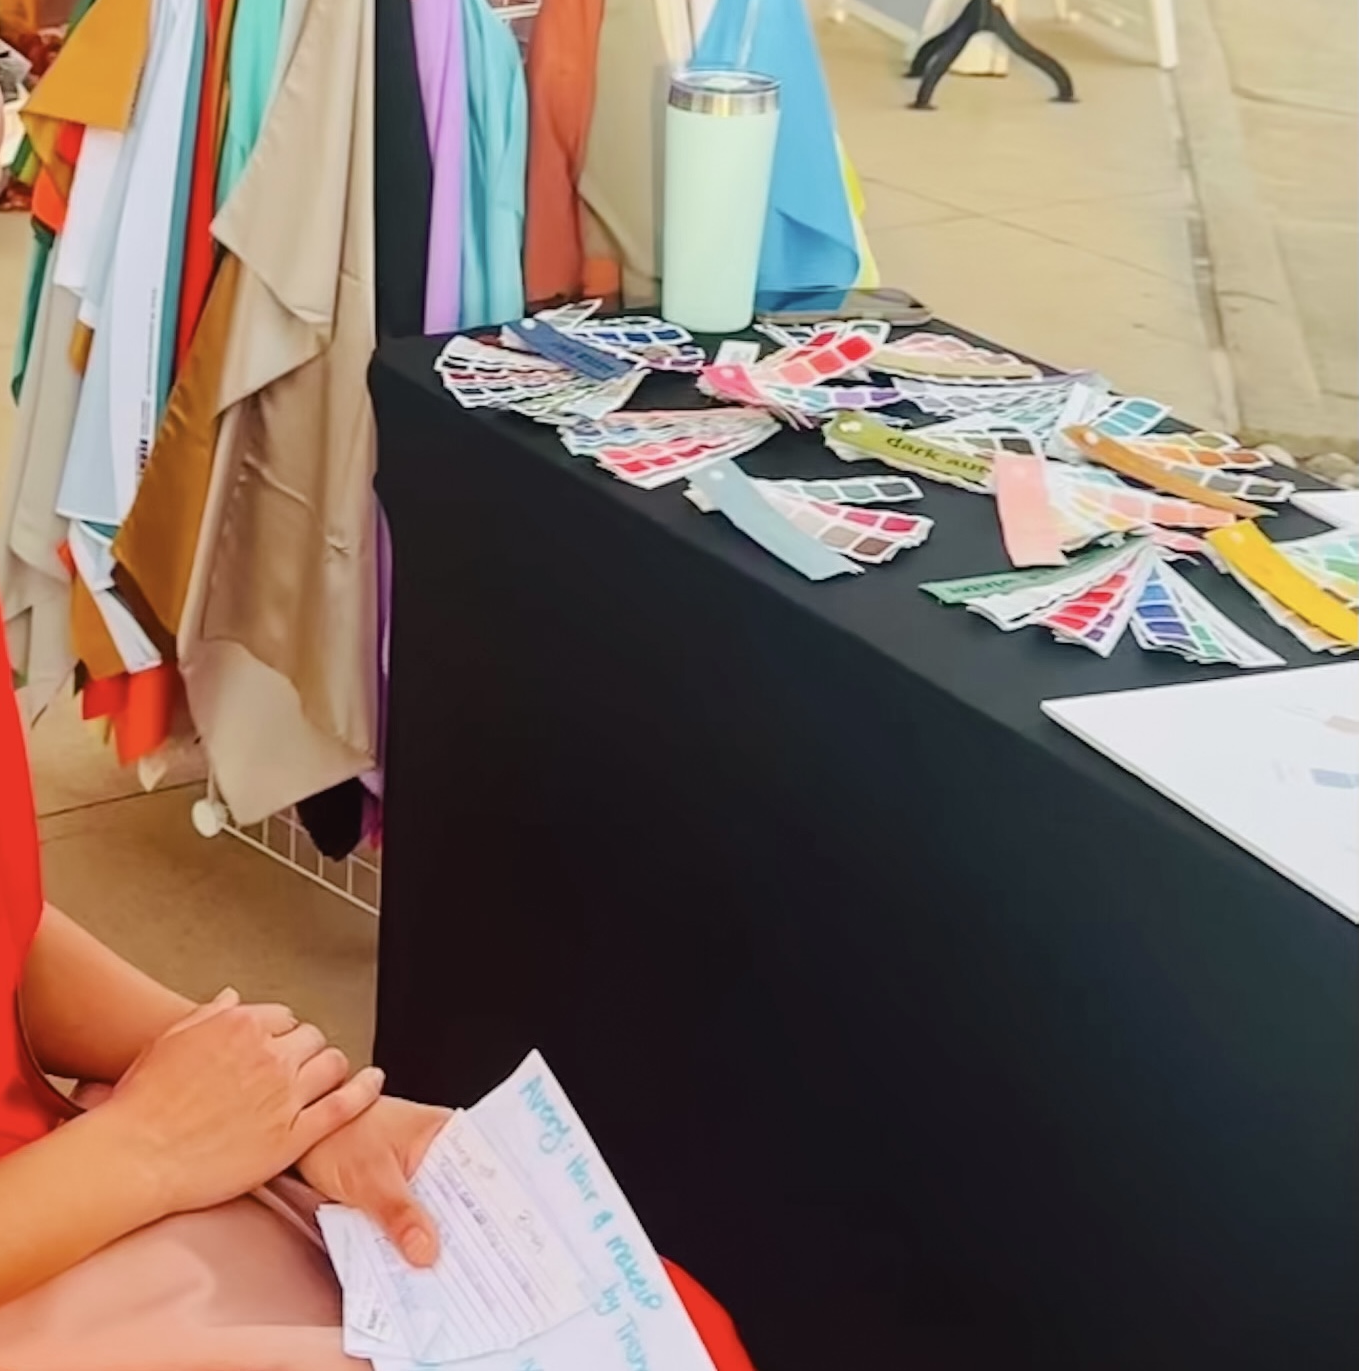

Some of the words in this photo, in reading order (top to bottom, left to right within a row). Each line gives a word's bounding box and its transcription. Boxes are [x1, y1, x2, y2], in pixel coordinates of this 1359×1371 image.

[886, 438, 939, 462] dark
[565, 1153, 600, 1202] Hair
[591, 1280, 622, 1317] by
